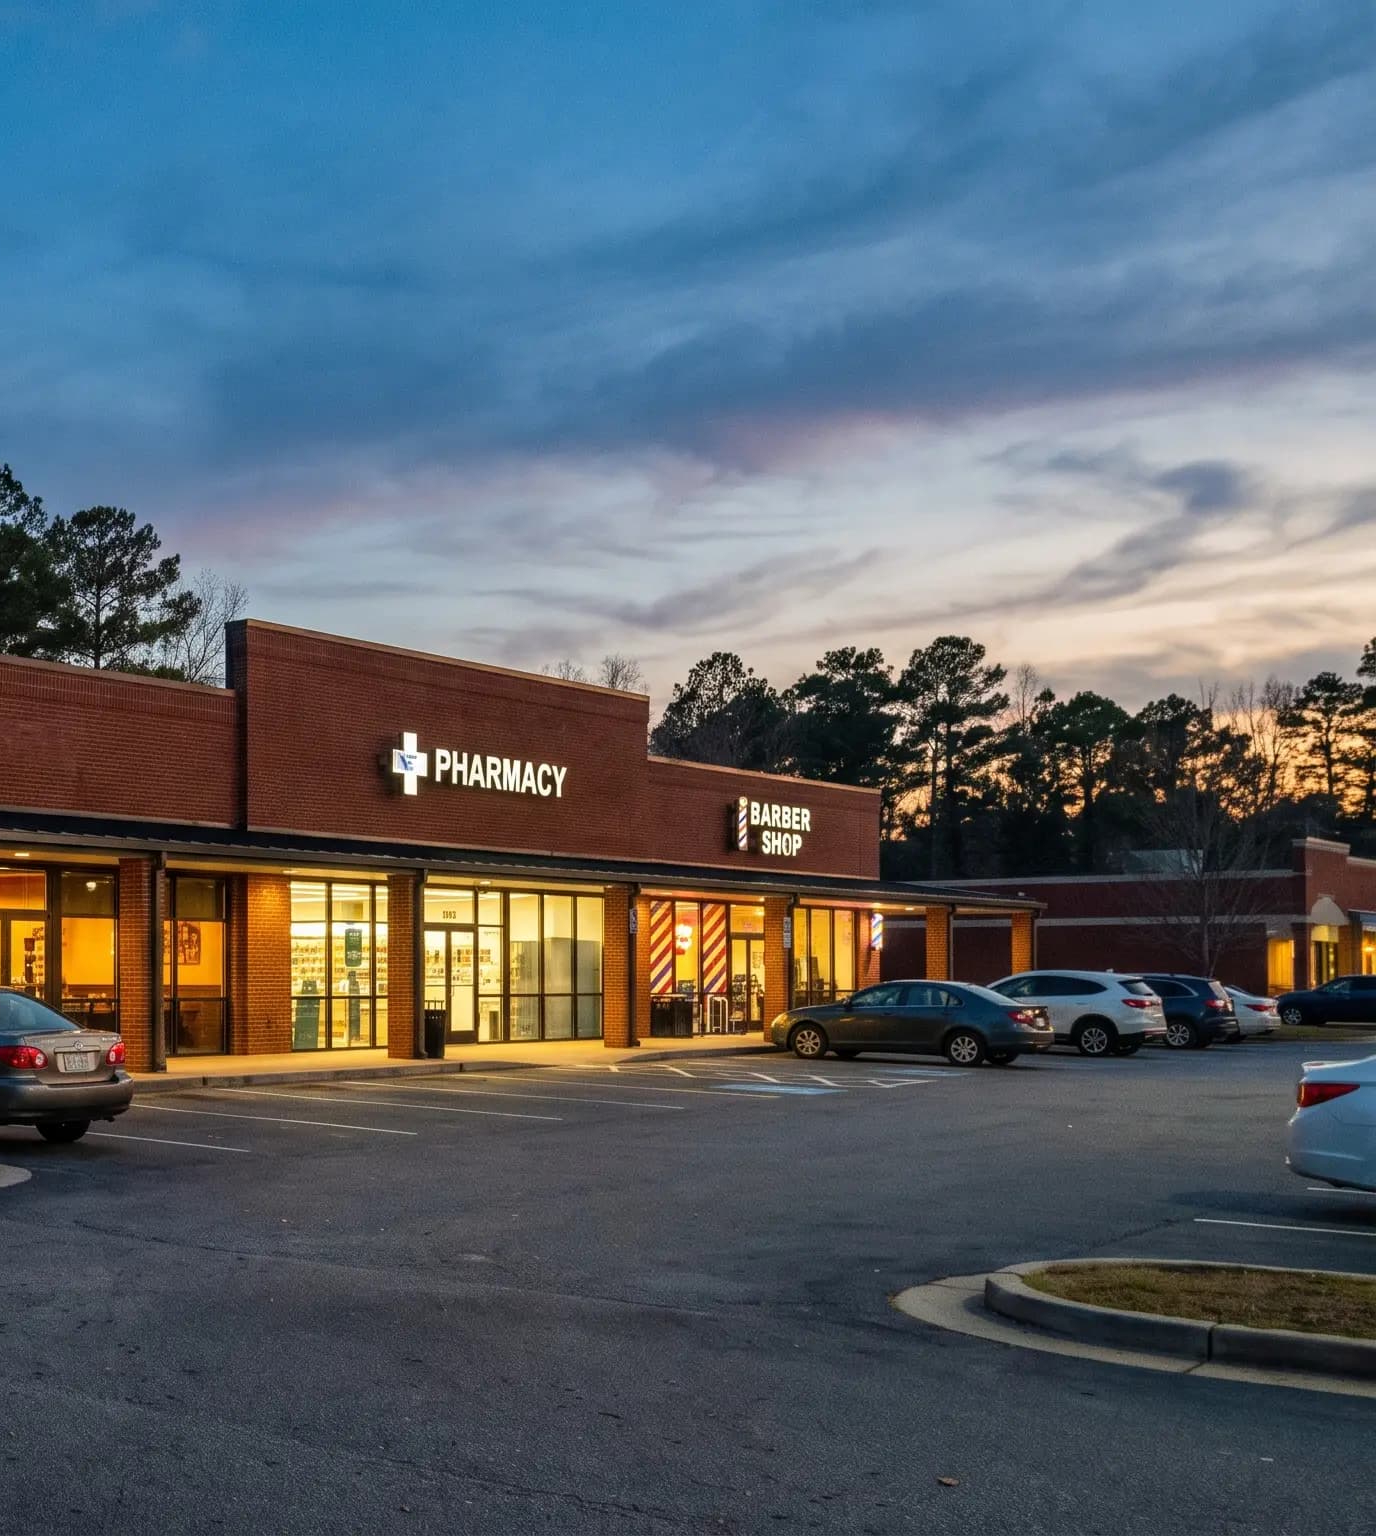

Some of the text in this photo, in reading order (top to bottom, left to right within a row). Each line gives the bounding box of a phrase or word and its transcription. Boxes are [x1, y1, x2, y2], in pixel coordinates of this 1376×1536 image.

[435, 748, 568, 798] PHARMACY
[750, 801, 811, 832] BARBER
[761, 830, 803, 857] SHOP
